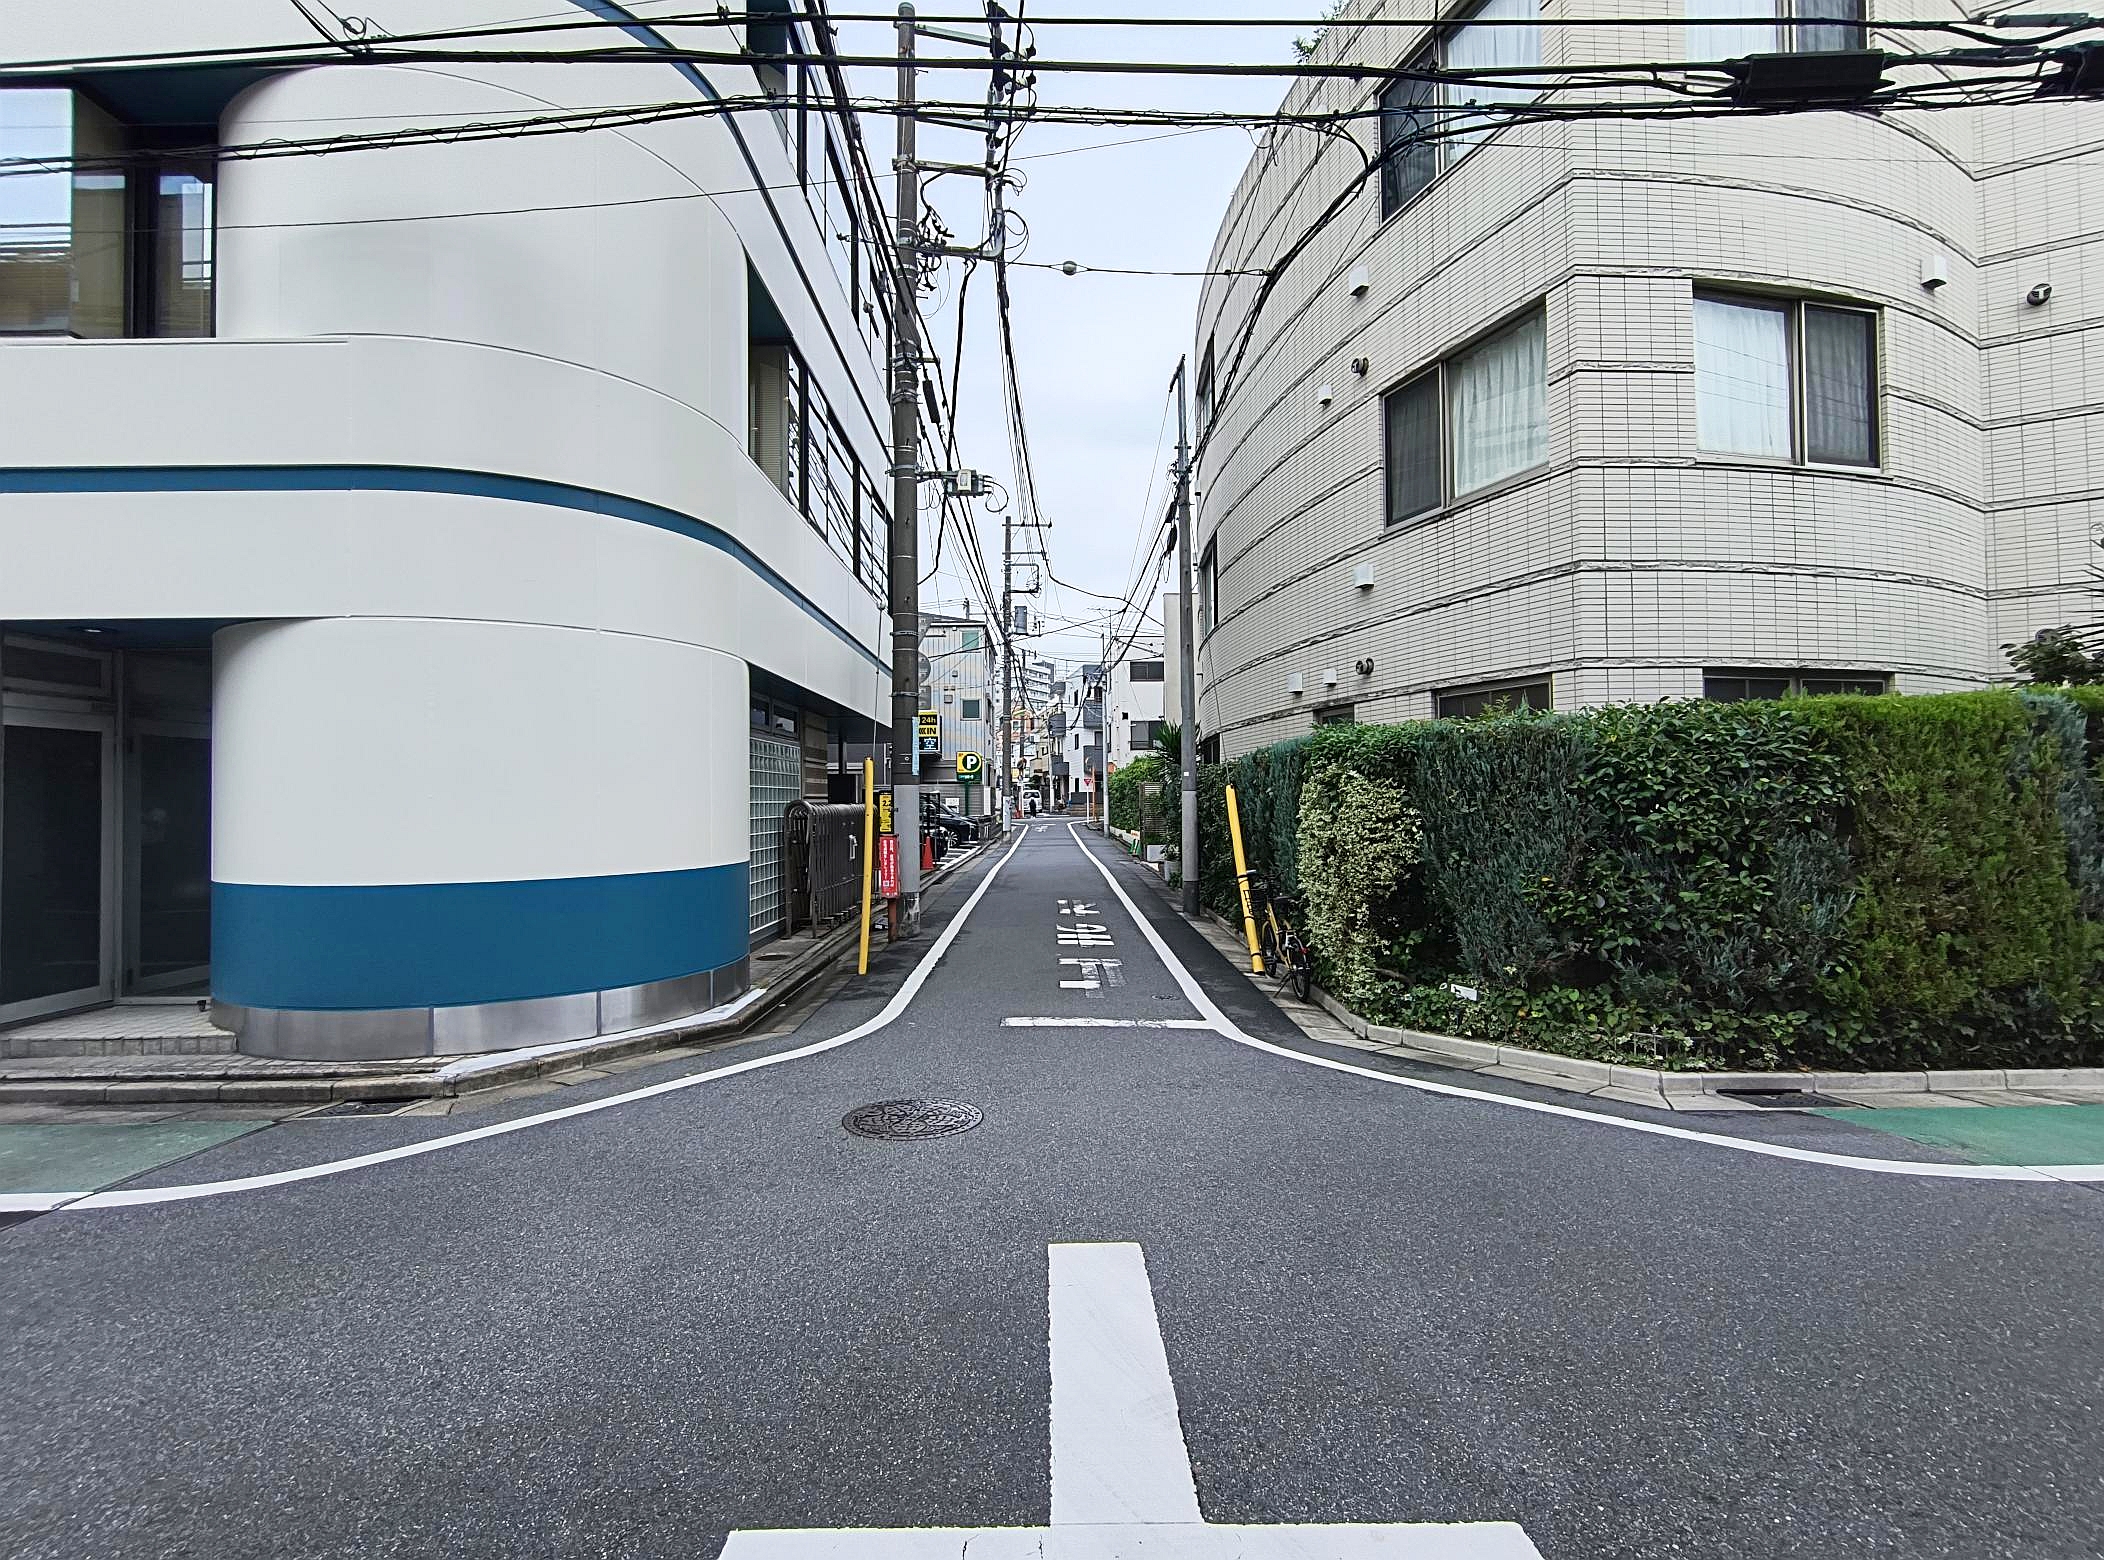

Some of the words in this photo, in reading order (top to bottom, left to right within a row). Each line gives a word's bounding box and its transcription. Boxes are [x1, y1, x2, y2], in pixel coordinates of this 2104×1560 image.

[921, 716, 936, 724] 24h
[924, 737, 937, 750] 空
[966, 755, 978, 770] P
